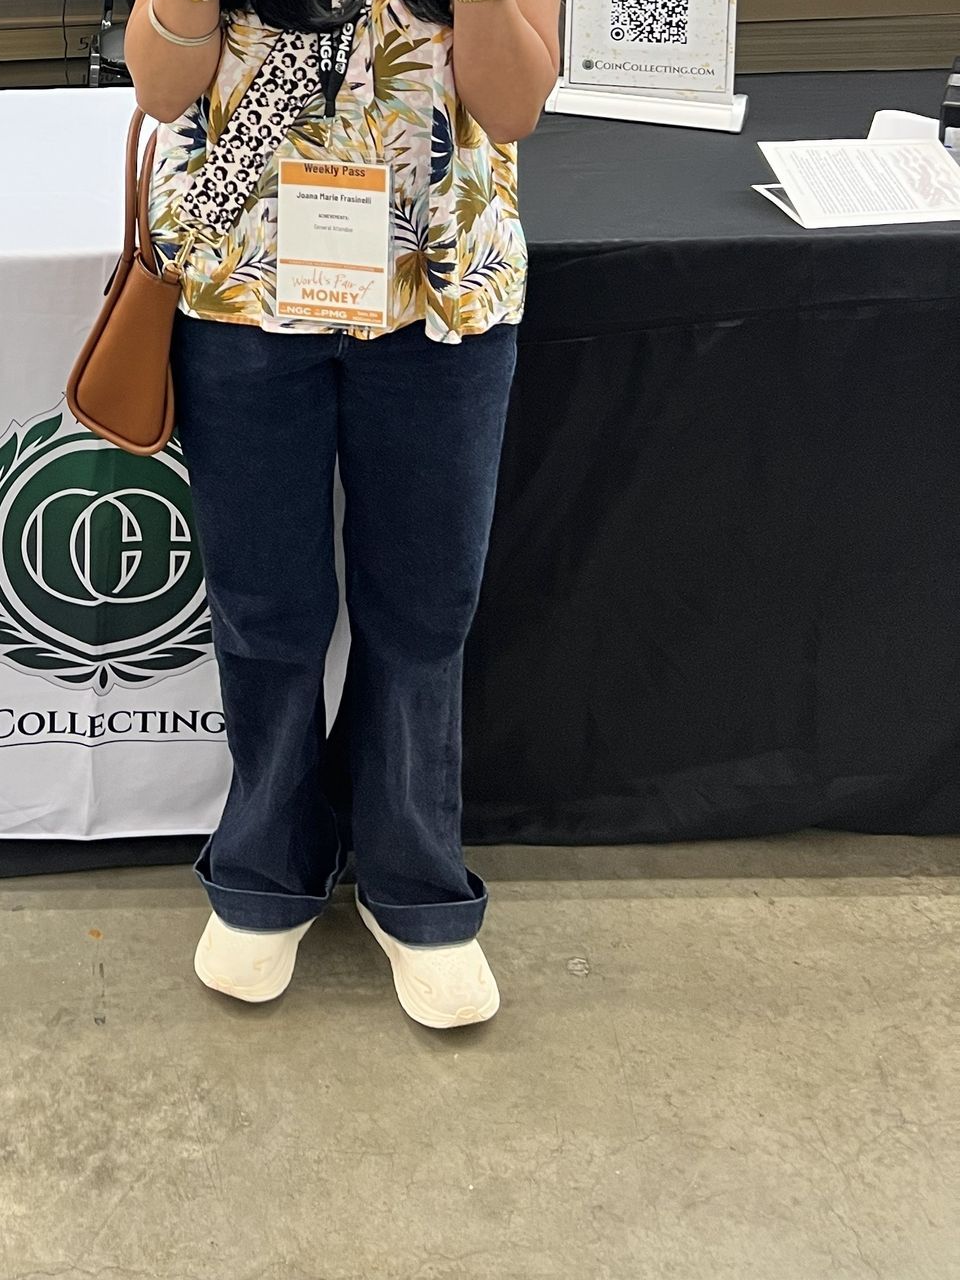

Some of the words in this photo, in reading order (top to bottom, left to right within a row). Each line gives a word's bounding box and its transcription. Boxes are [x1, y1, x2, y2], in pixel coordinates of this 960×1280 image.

[336, 22, 355, 64] PMG
[320, 33, 333, 72] NGC
[304, 163, 339, 177] Weekly
[342, 166, 366, 177] Pass
[296, 191, 318, 200] Joana
[320, 193, 338, 202] Marie
[340, 194, 371, 205] Frasinelli
[301, 287, 359, 304] MONEY
[287, 306, 312, 315] NGC
[321, 309, 348, 319] PMG
